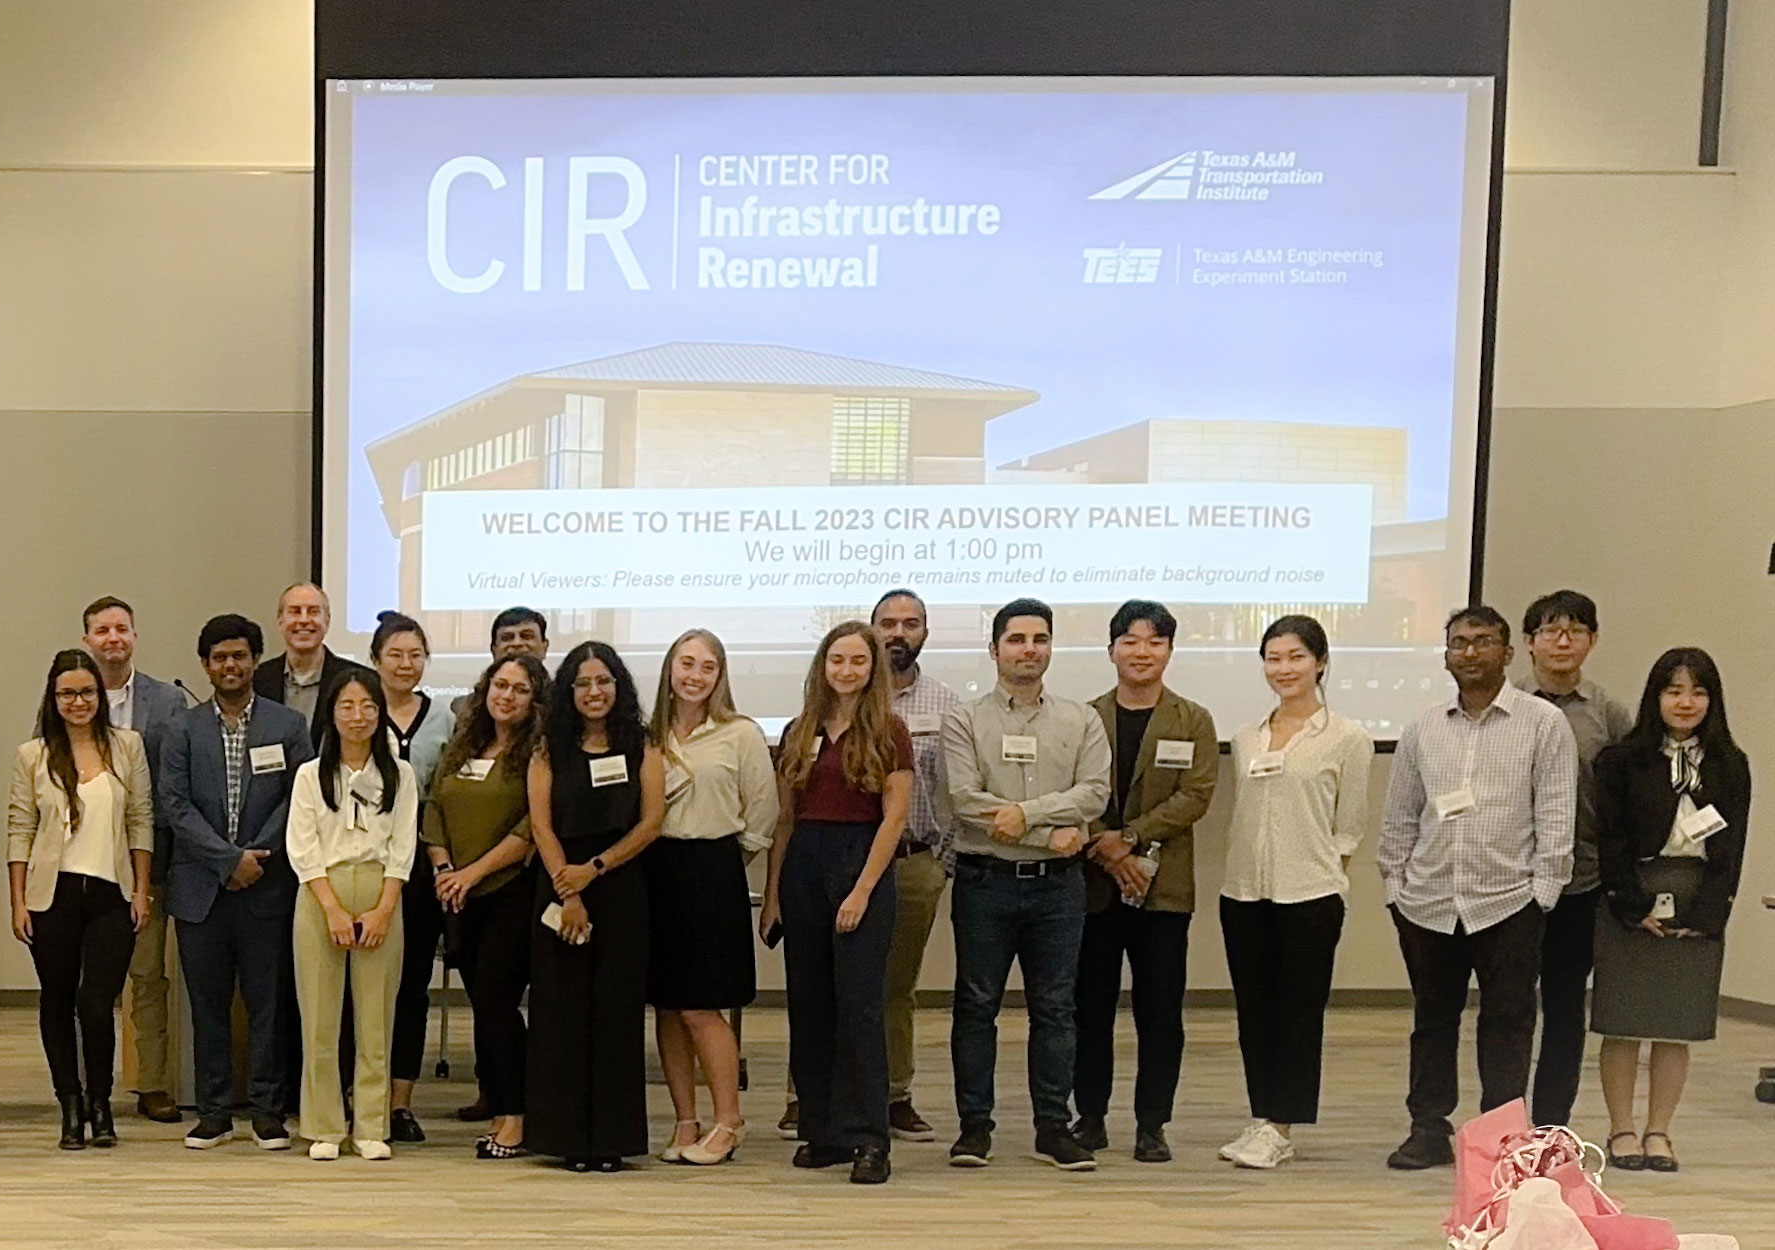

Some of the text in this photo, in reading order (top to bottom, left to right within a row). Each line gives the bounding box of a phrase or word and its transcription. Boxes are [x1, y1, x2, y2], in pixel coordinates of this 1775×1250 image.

[699, 154, 890, 187] CENTER FOR
[1201, 150, 1296, 168] Texas A&M
[1195, 183, 1269, 201] Institute
[1198, 167, 1324, 188] Transportation
[427, 155, 650, 293] CIR
[699, 194, 1001, 238] Infrastructure
[697, 244, 879, 289] Renewal
[1083, 247, 1163, 283] TEES
[1193, 247, 1384, 268] Texas A&M Engineering
[1192, 267, 1348, 288] Experiment Station
[481, 505, 1311, 535] WELCOME TO THE FALL 2023 CIR ADVISORY PANEL MEETING
[744, 537, 1043, 567] We will begin at 1:00 pm
[467, 564, 1325, 591] Virtual Viewers: Please ensure your microphone remains muted to eliminate background noise
